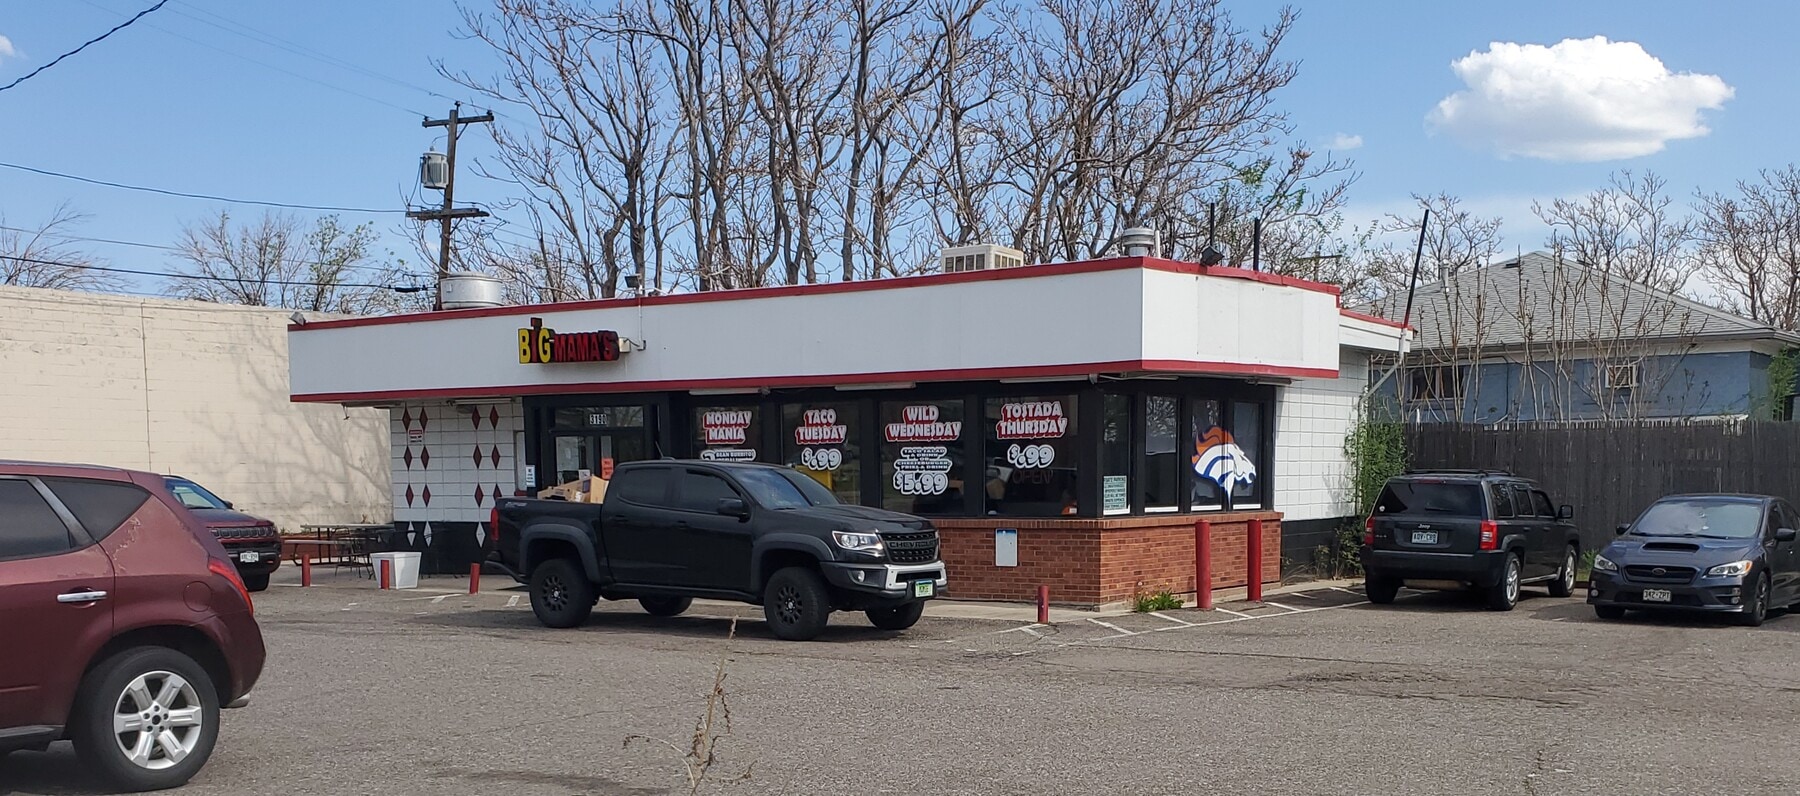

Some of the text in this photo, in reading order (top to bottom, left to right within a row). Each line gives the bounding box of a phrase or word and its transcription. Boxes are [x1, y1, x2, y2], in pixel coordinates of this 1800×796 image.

[519, 317, 617, 363] BIG MAMA'S
[704, 411, 752, 426] MONDAY
[805, 409, 836, 425] TACO
[904, 406, 939, 423] WILD
[1004, 402, 1063, 419] TOSTADA
[707, 427, 745, 442] MANIA
[797, 425, 846, 442] TUESDAY
[887, 422, 961, 440] WEDNESDAY
[998, 418, 1067, 436] THURSDAY
[803, 449, 841, 469] $.99
[1009, 445, 1053, 467] $.99
[895, 473, 946, 492] $5.99
